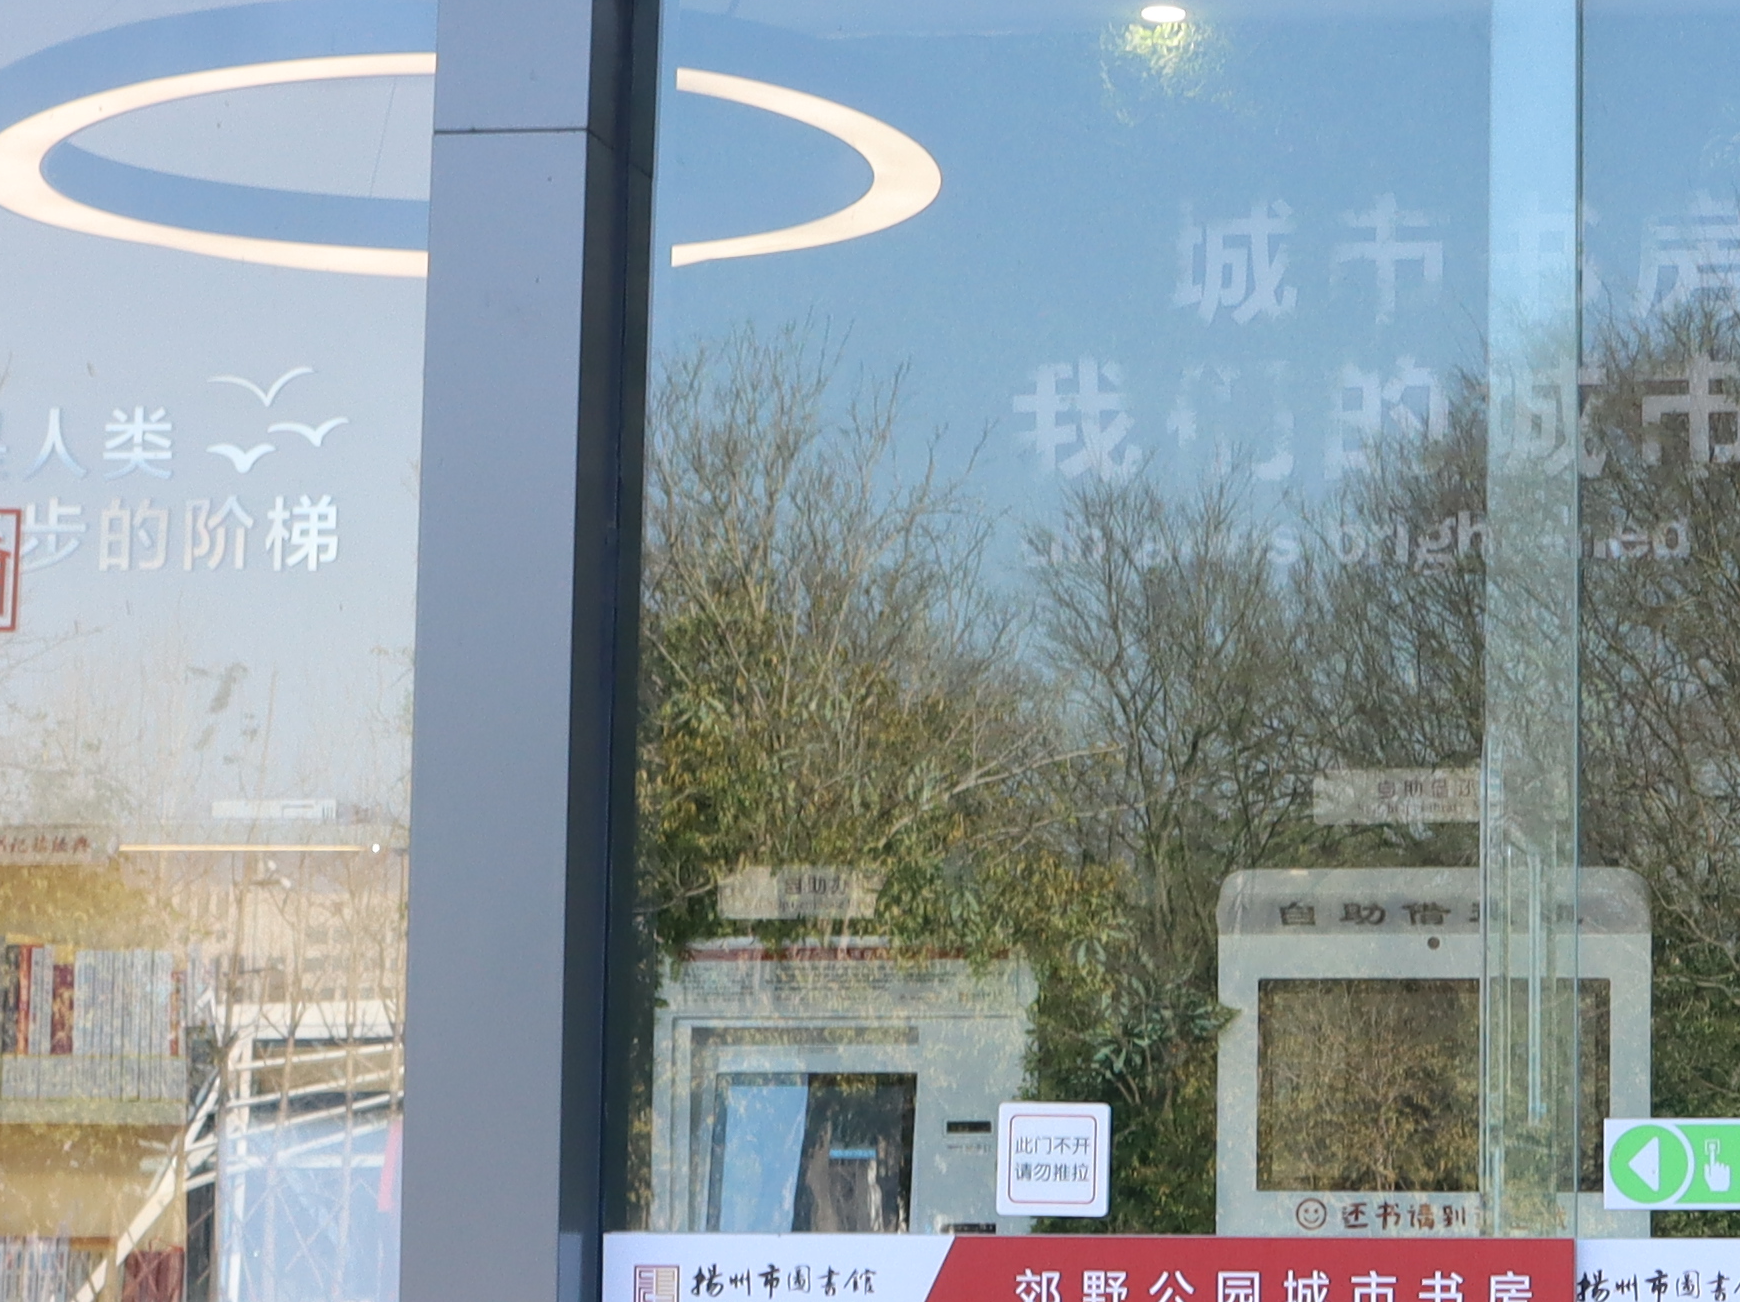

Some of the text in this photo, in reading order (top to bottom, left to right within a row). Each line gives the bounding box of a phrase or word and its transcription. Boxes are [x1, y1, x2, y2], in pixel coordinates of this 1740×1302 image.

[1013, 1134, 1092, 1156] 此门不开
[1013, 1160, 1091, 1184] 请勿推拉
